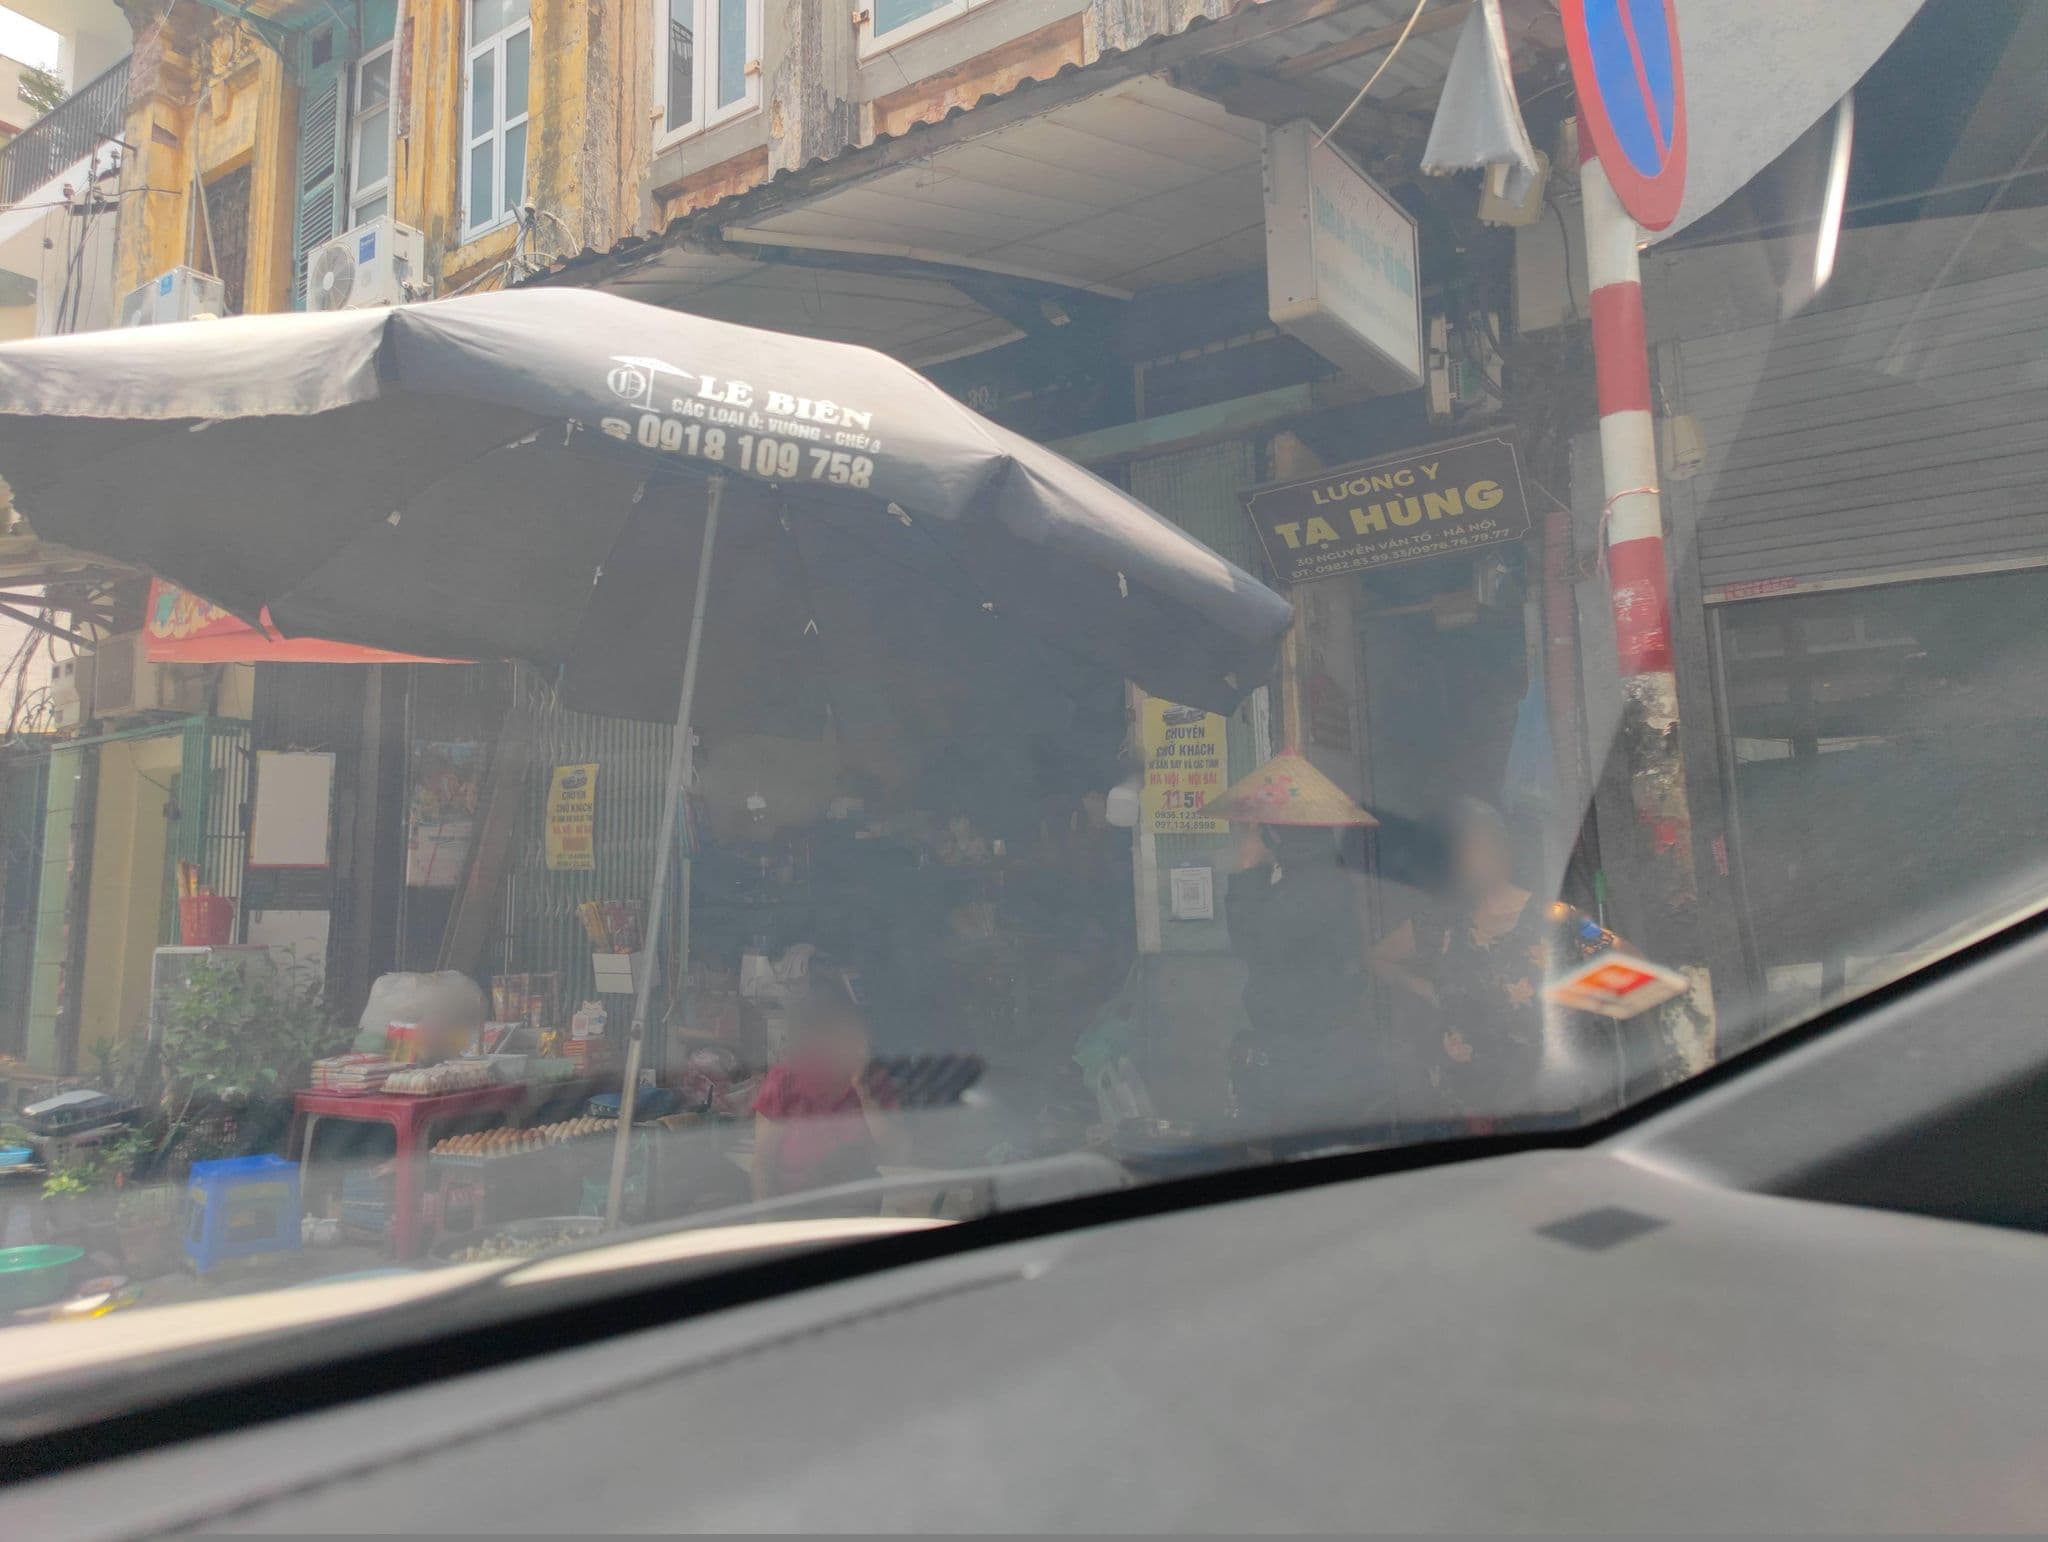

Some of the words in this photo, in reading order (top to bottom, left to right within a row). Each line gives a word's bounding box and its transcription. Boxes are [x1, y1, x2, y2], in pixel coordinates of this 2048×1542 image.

[672, 398, 705, 418] CÁC
[708, 406, 745, 428] LOẠI
[768, 418, 821, 441] VUÔNG
[697, 375, 753, 408] LÊ
[765, 390, 873, 431] BIÊN
[637, 414, 727, 462] 0918
[738, 434, 800, 479] 109
[809, 448, 874, 490] 758
[1312, 469, 1416, 505] LƯƠNG
[1418, 462, 1440, 481] Y
[1274, 516, 1340, 549] TẠ
[1350, 480, 1505, 536] HÙNG
